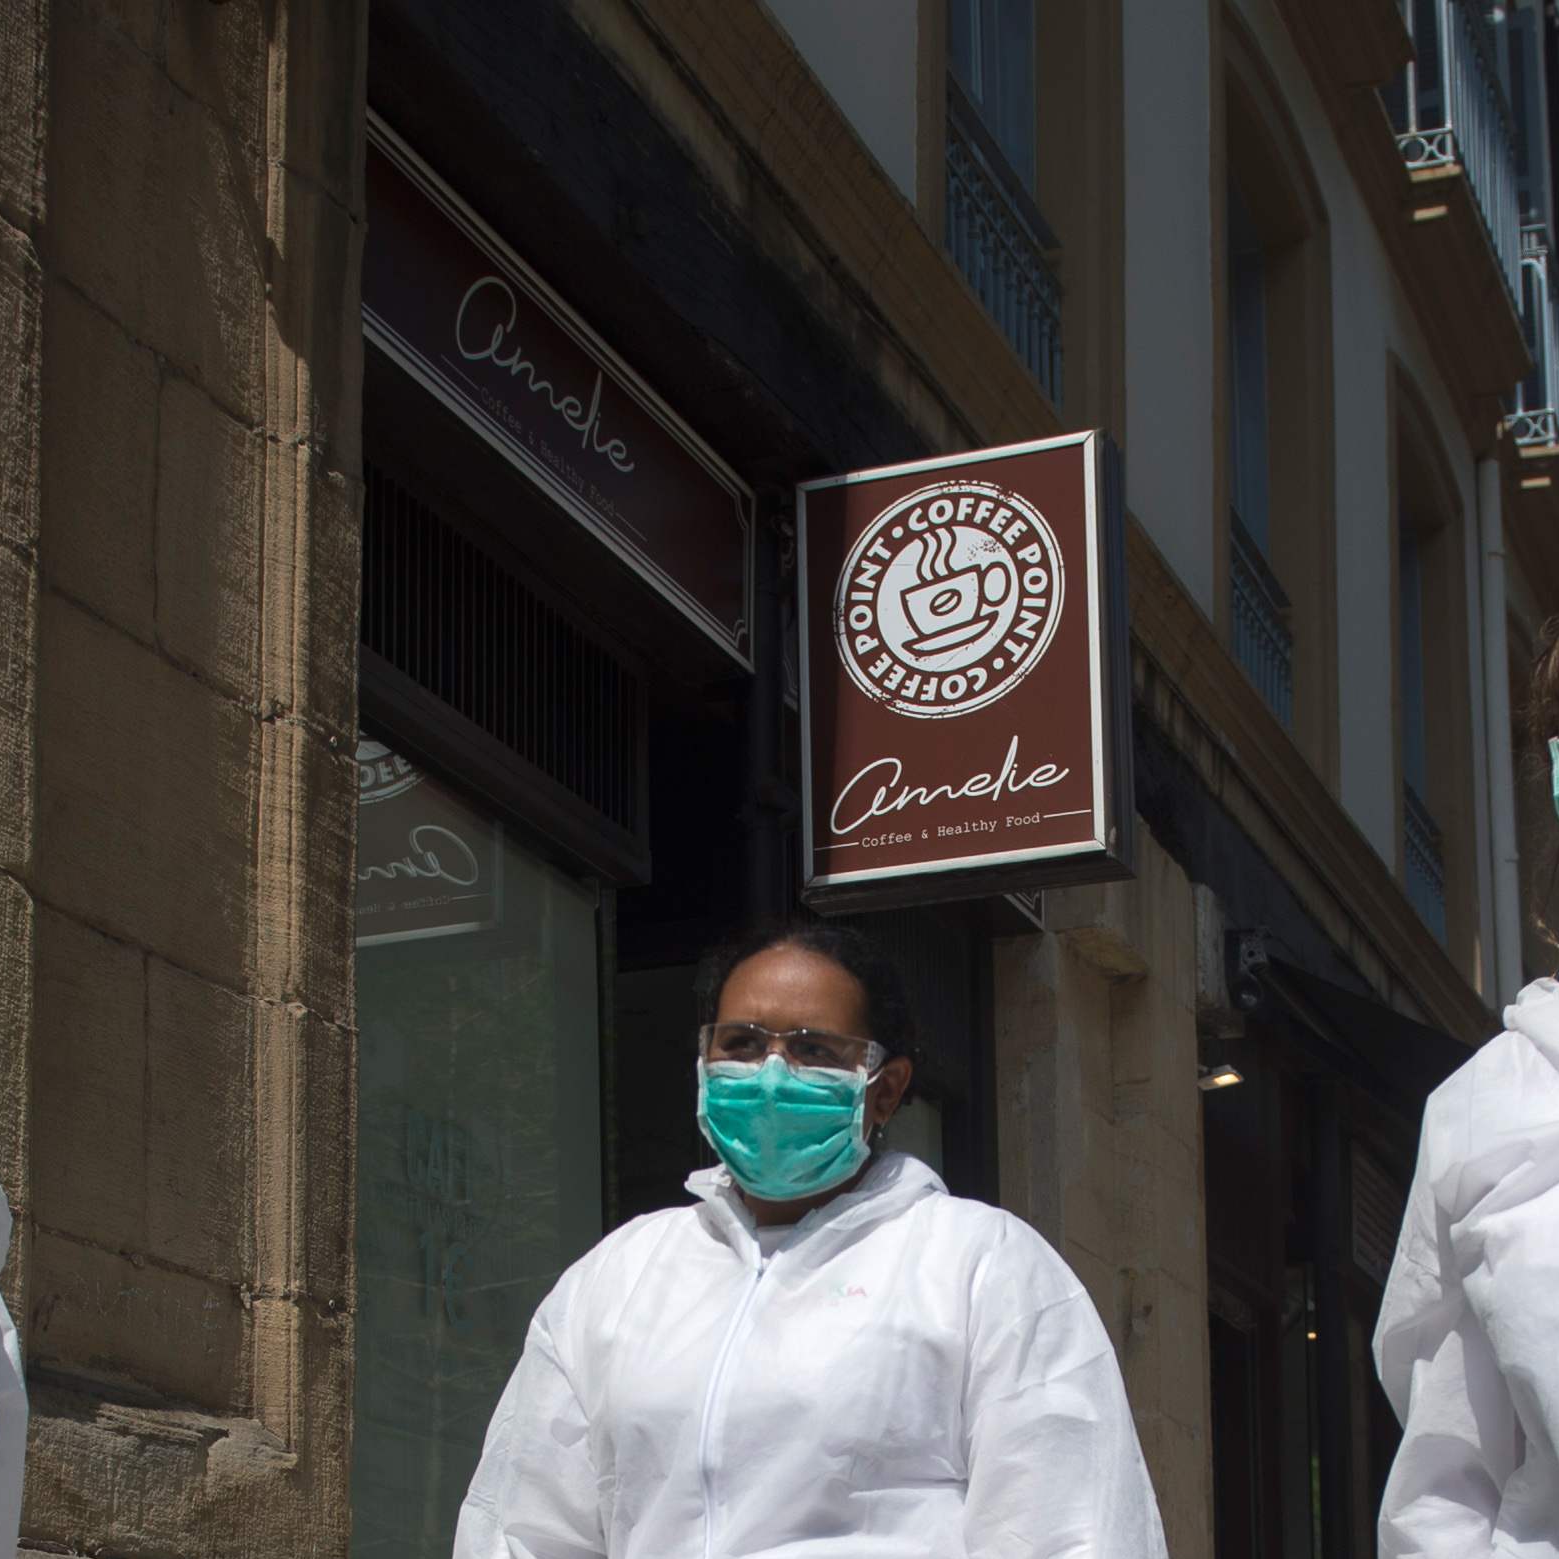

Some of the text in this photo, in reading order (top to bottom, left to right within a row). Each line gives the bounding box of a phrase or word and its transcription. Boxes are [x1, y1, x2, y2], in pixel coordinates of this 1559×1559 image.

[848, 536, 989, 701] COFFEE POINT
[908, 497, 1049, 668] COFFEE POINT
[861, 812, 1041, 849] Coffee & Healthy Food
